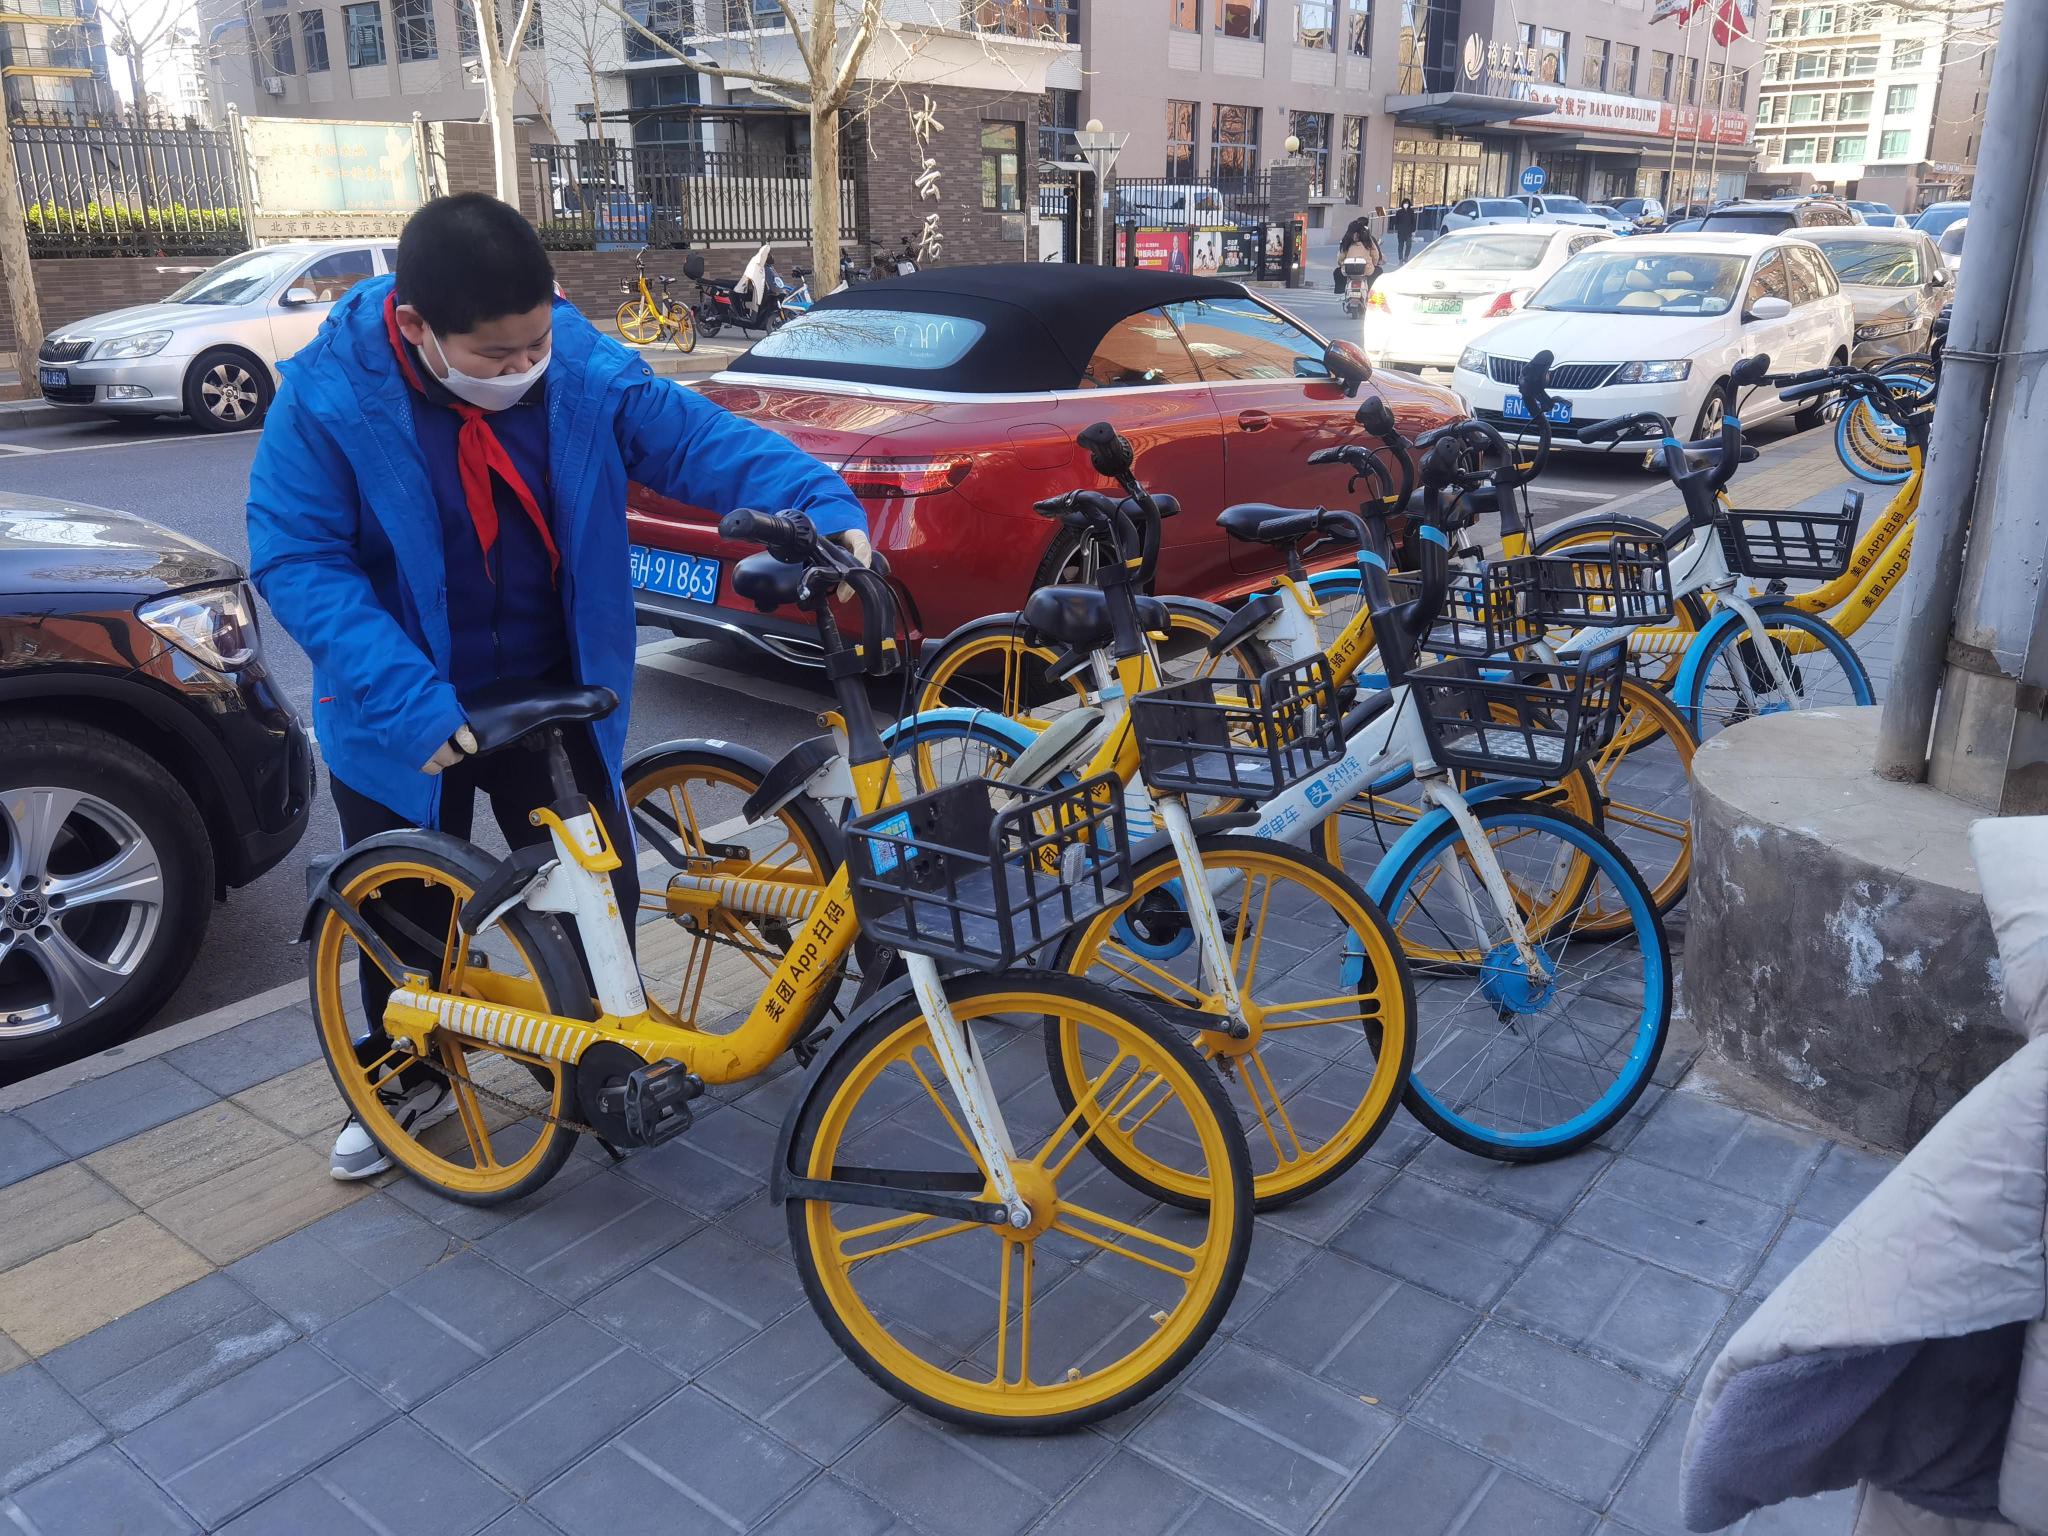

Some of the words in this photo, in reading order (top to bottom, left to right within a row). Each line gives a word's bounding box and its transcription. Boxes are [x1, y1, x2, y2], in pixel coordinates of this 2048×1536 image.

[1487, 40, 1537, 72] 裕友大厦
[1487, 69, 1507, 80] YUYOU
[1509, 72, 1535, 83] MANSION
[1590, 102, 1612, 117] BANK
[1614, 105, 1625, 118] OF
[1626, 107, 1657, 122] BEIJING
[913, 94, 944, 263] 水云居
[1523, 172, 1544, 185] 出口
[270, 220, 408, 234] 北京市安全警示宣传
[1851, 555, 1872, 578] 美团
[1883, 511, 1904, 535] 扫码
[1861, 584, 1885, 608] 美团
[1881, 561, 1901, 585] App
[1327, 755, 1360, 786] 支付宝
[1333, 768, 1364, 793] ALIPAY
[764, 978, 797, 1023] 美团
[789, 942, 818, 983] App
[812, 899, 846, 945] 扫码
